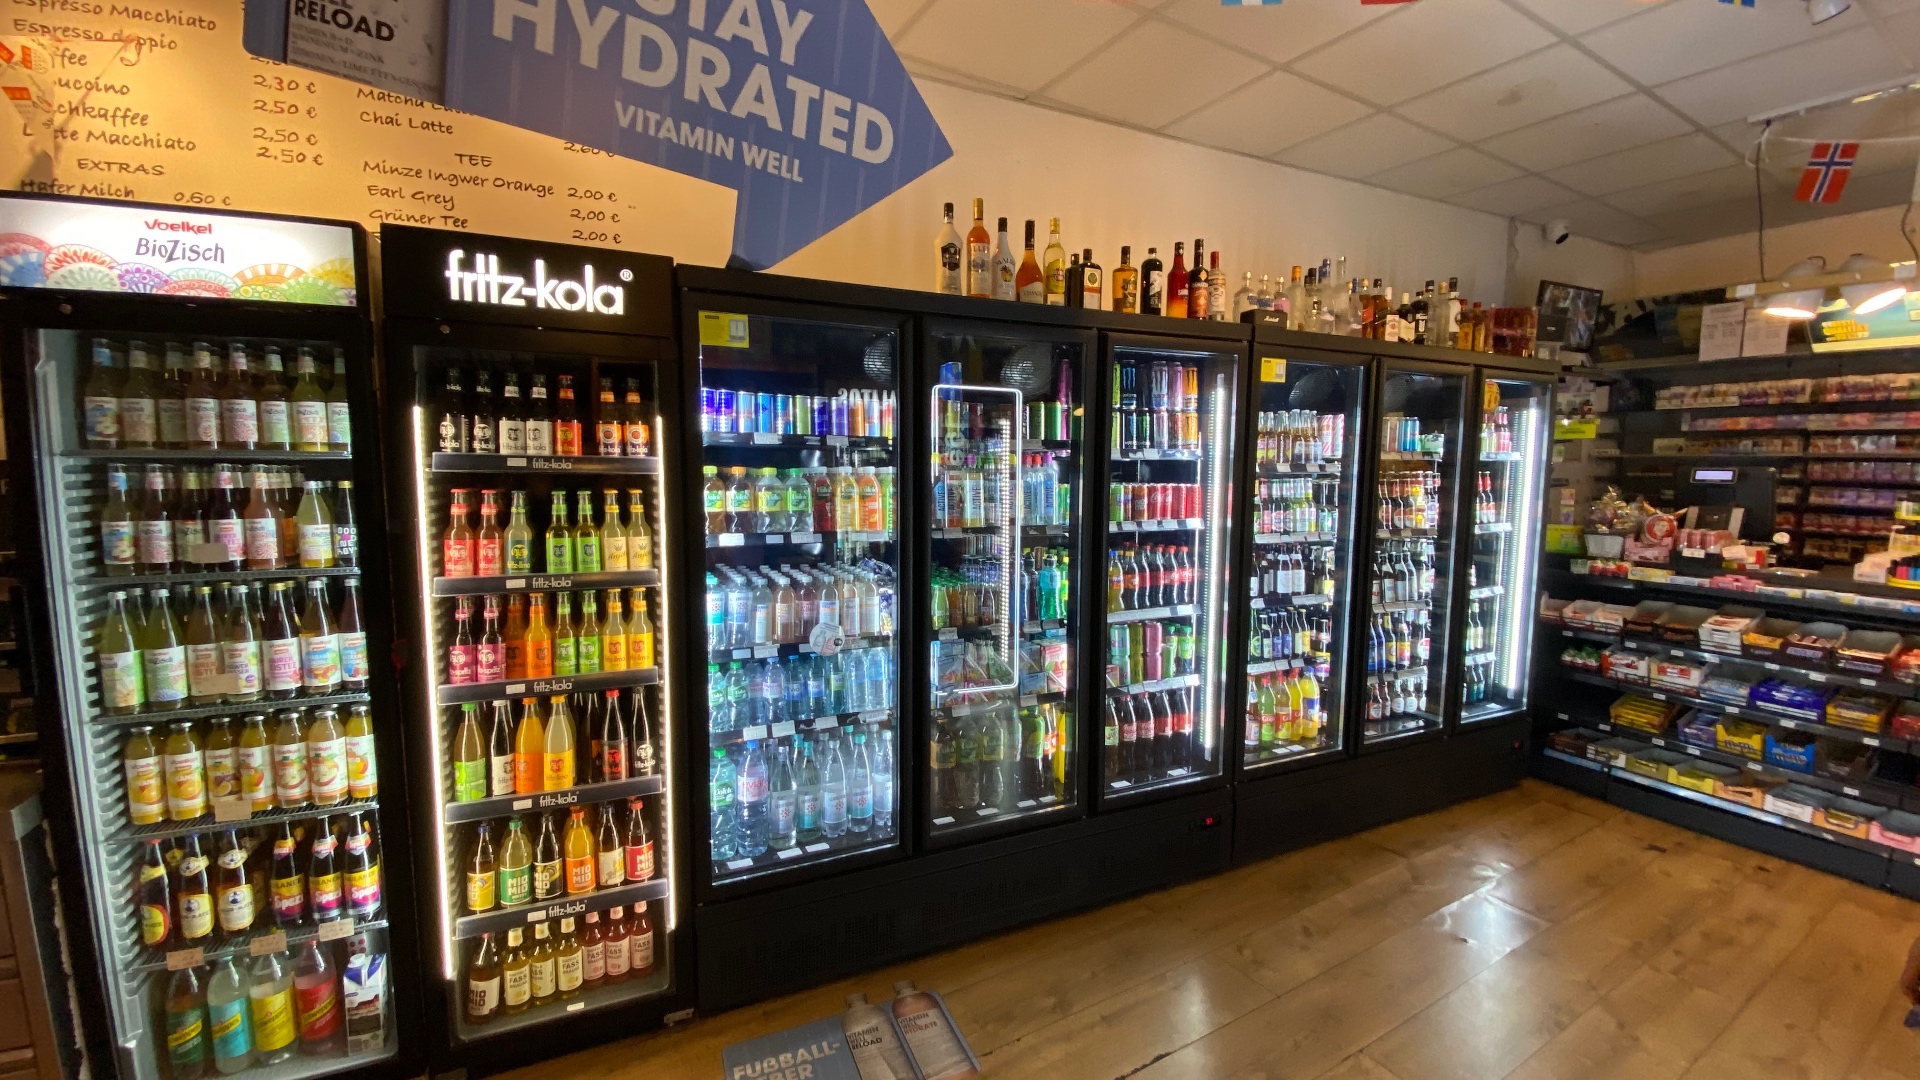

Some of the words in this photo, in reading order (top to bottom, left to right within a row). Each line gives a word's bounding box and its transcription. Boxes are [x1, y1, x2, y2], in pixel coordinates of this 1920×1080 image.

[109, 5, 217, 31] Macchiato
[294, 1, 394, 42] RELOAD
[492, 0, 894, 164] HYDRATED
[360, 111, 401, 127] Chai
[409, 117, 453, 134] Latte
[86, 129, 197, 151] Macchiato
[614, 99, 735, 161] VITAMIN
[742, 142, 804, 183] WELL
[77, 158, 165, 176] EXTRAS
[454, 153, 492, 167] TEE
[80, 181, 135, 199] Milch
[363, 160, 422, 179] Minze
[428, 169, 489, 187] Ingwer
[493, 177, 555, 198] Orange
[367, 185, 403, 200] Earl
[411, 191, 455, 211] Grey
[144, 218, 213, 236] Voelkel
[369, 209, 435, 226] Grüner
[443, 215, 468, 228] Tee
[135, 238, 225, 264] BioZisch
[562, 960, 579, 969] FASS
[509, 974, 527, 983] FASS
[852, 1038, 882, 1050] RELOAD
